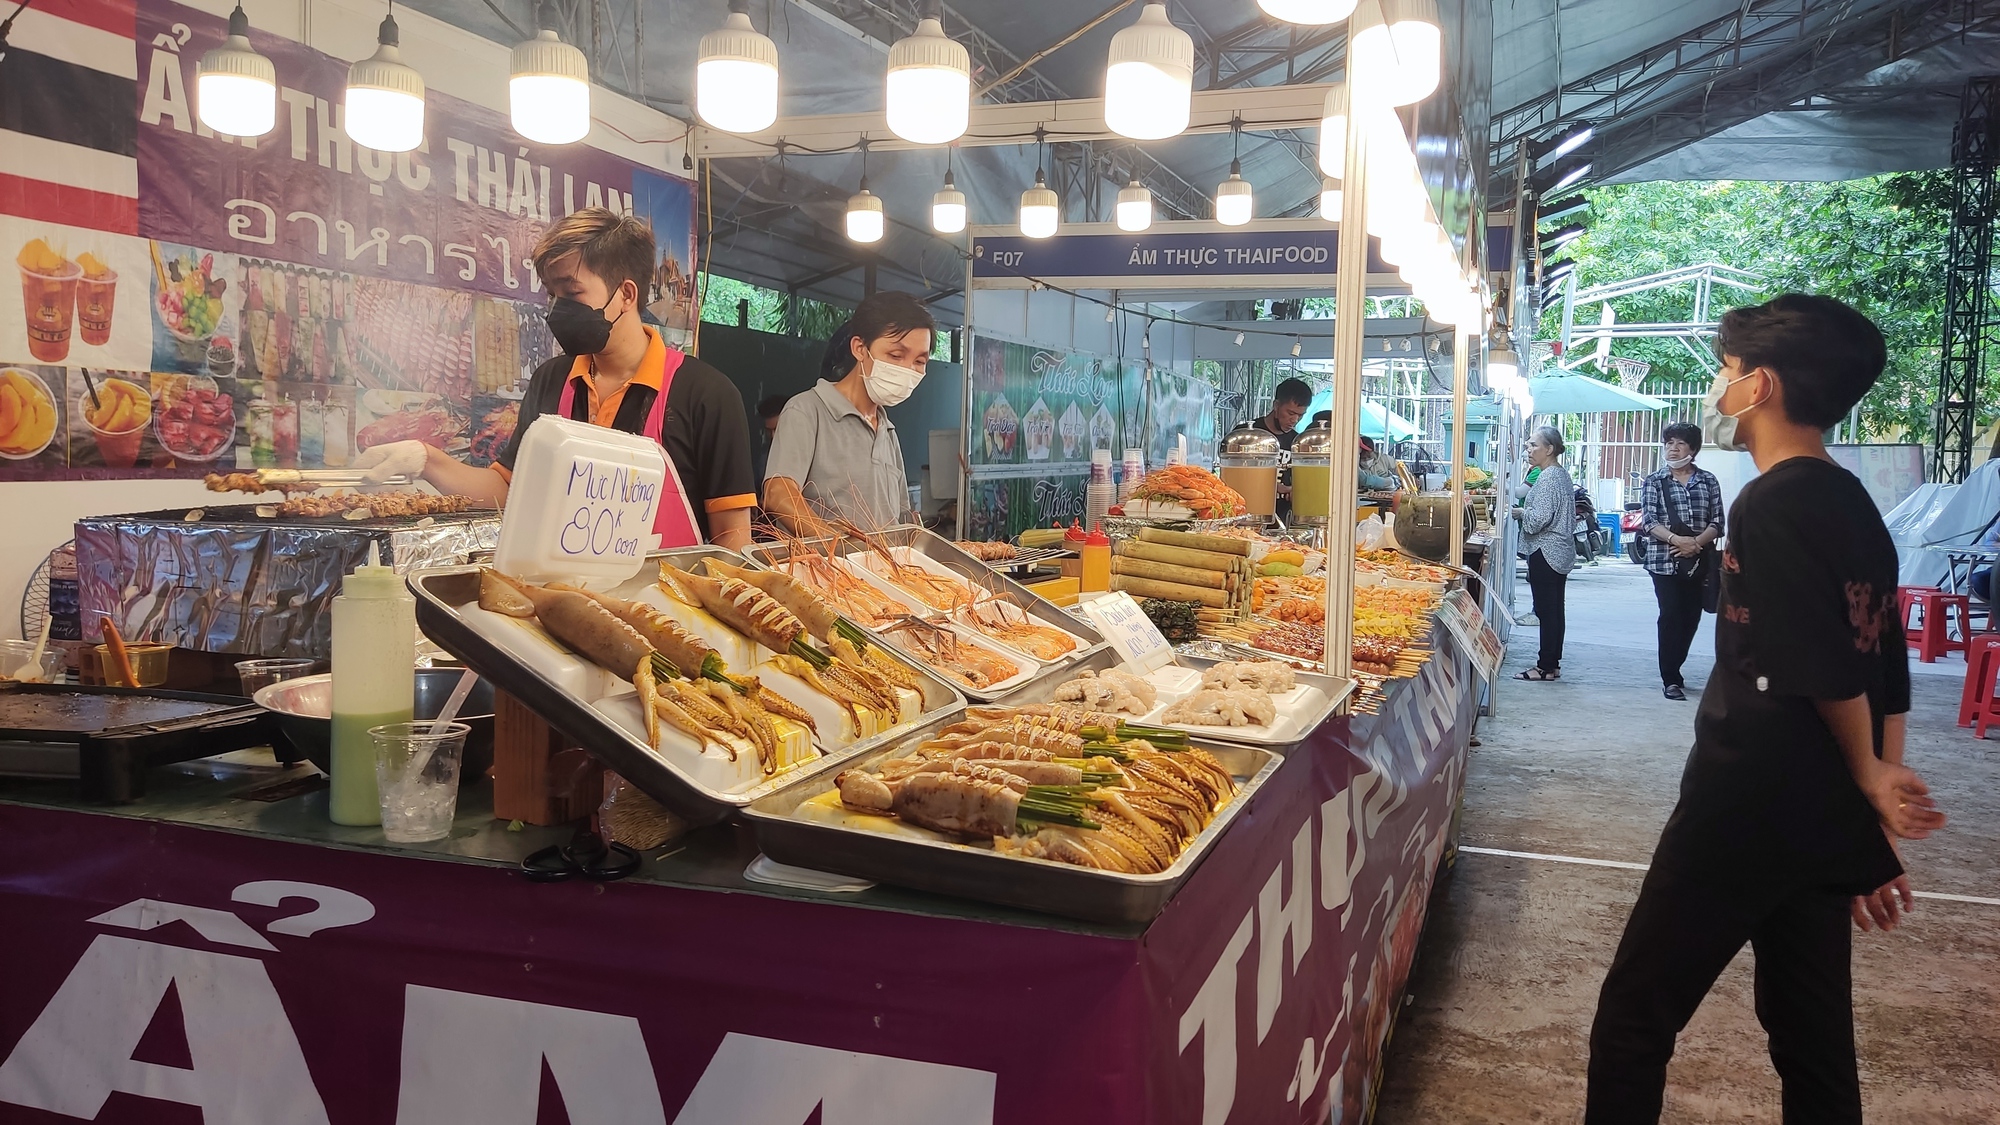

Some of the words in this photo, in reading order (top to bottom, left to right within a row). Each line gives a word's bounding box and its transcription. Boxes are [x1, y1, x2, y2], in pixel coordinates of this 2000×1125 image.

[140, 22, 258, 149] Ẩ
[447, 137, 551, 224] THÁI
[992, 251, 1024, 267] F07
[1127, 242, 1158, 266] ẨM
[1164, 246, 1218, 269] THỰC
[1224, 245, 1329, 265] THAIFOOD
[567, 460, 608, 506] Mực
[611, 466, 656, 522] Nướng
[615, 537, 639, 557] con
